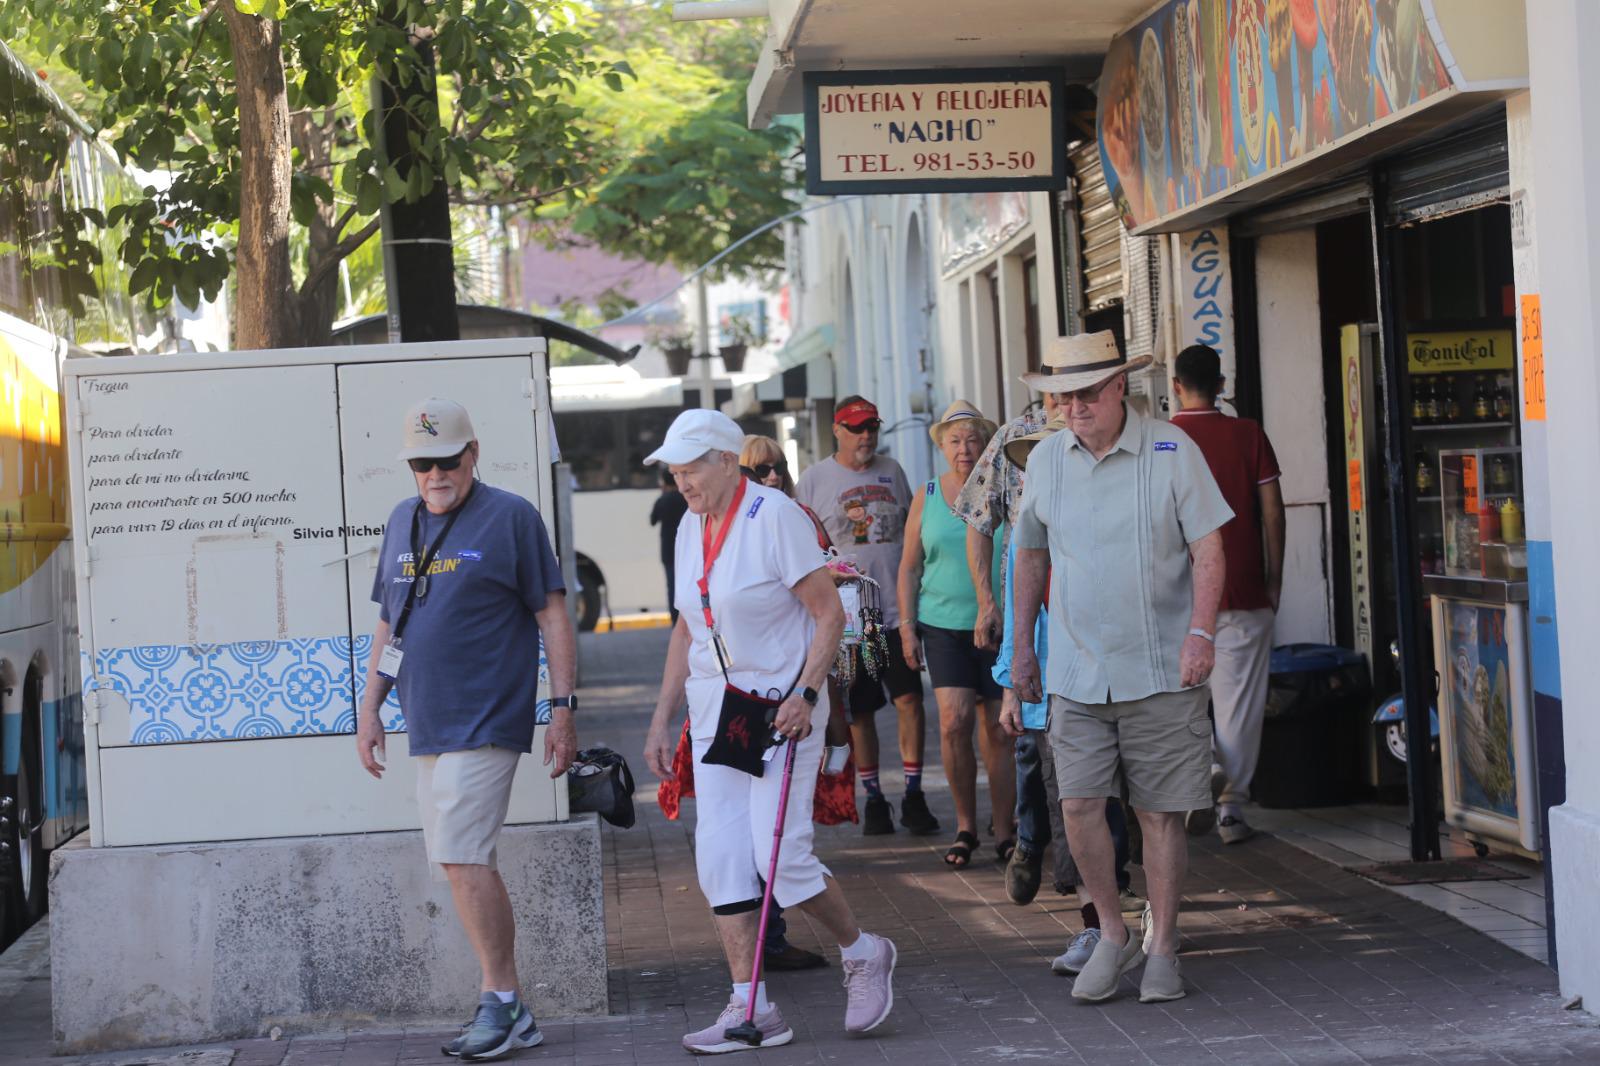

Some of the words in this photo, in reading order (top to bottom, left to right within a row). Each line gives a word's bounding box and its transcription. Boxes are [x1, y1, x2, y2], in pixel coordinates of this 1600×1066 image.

[821, 90, 905, 114] JOYERIA
[912, 91, 924, 111] Y
[937, 89, 1048, 111] RELOJERIA
[837, 154, 904, 173] TEL.
[913, 151, 1035, 171] 981-53-50
[1191, 230, 1224, 345] AGUAS
[84, 379, 129, 395] Tregua
[88, 426, 122, 440] Para
[126, 423, 174, 438] olvidar
[88, 454, 121, 468] para
[124, 447, 183, 461] olvidarte
[88, 476, 122, 491] para
[125, 473, 143, 485] de
[145, 474, 162, 484] mi
[164, 474, 181, 483] no
[184, 468, 251, 482] olvidarme
[90, 501, 122, 515] para
[126, 496, 200, 509] encontrarte
[202, 496, 218, 505] en
[222, 492, 252, 504] 500
[256, 488, 297, 502] noches
[91, 525, 124, 539] para
[160, 519, 175, 531] 19
[208, 519, 223, 528] en
[227, 513, 241, 528] el
[293, 526, 334, 540] Silvia
[338, 524, 385, 538] Michel
[397, 552, 420, 562] KEE
[402, 558, 461, 576] TRVELIN'
